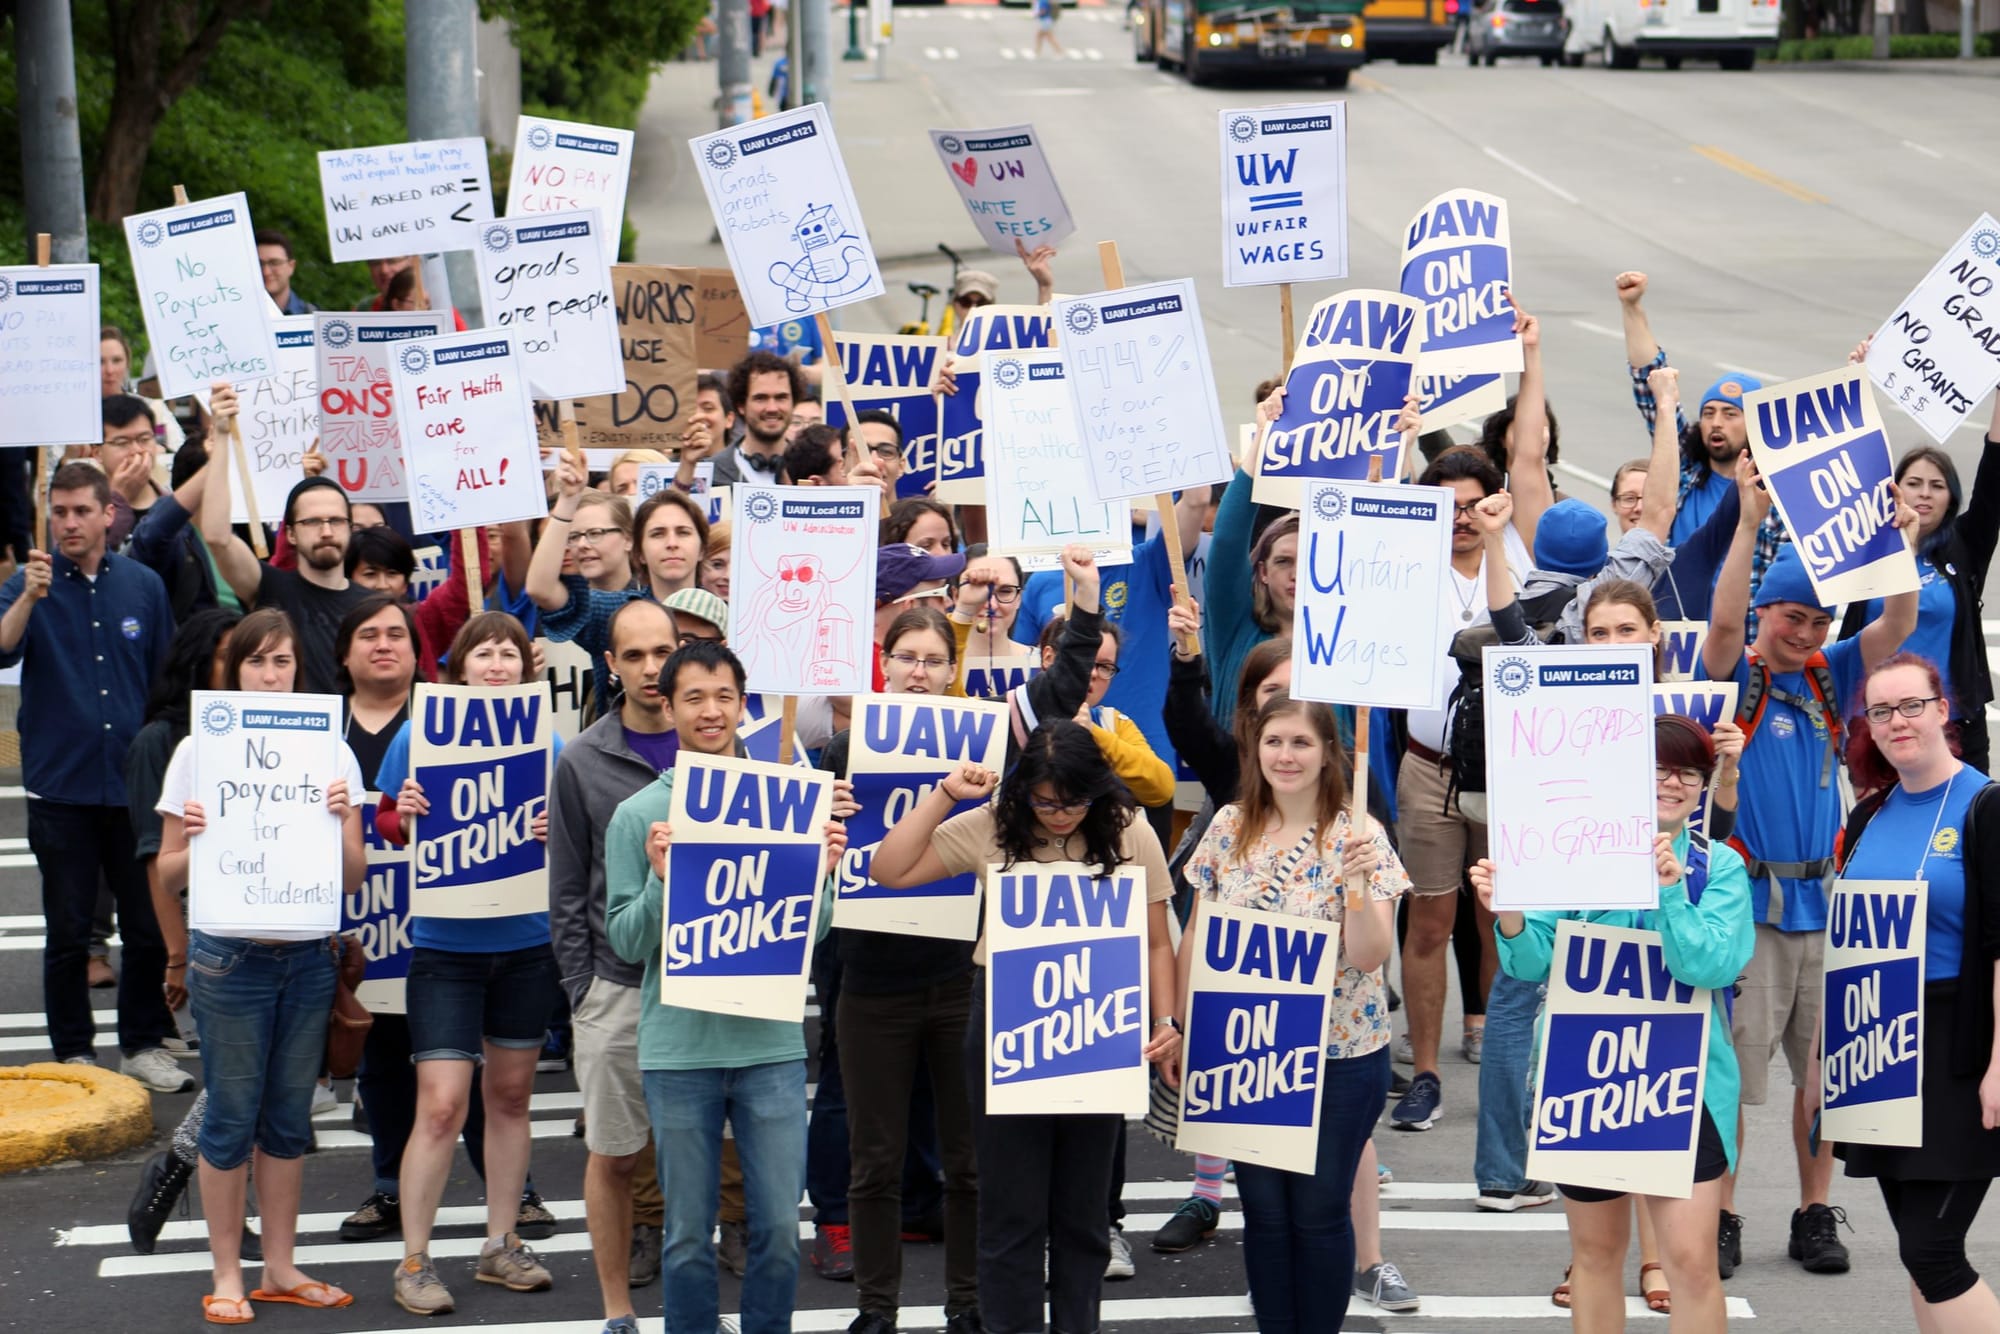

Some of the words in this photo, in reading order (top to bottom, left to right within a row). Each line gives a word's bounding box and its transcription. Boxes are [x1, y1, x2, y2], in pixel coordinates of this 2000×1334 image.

[558, 136, 577, 146] UAW
[578, 139, 598, 149] Local
[600, 142, 618, 153] 4121
[743, 139, 766, 151] UAW
[767, 132, 791, 145] Local
[792, 125, 813, 138] 4121
[1010, 137, 1030, 146] 4121
[1264, 123, 1286, 132] UAW
[1286, 120, 1309, 130] Local
[1310, 119, 1330, 129] 4121
[524, 163, 567, 187] NO
[574, 167, 612, 192] PAY
[719, 165, 778, 194] Grads
[989, 159, 1025, 182] UW
[1235, 147, 1300, 187] UW
[330, 193, 360, 213] WE
[371, 188, 423, 207] ASKED
[431, 181, 459, 197] FOR
[968, 198, 1017, 216] HATE
[170, 220, 192, 233] UAW
[191, 216, 214, 230] Local
[214, 212, 234, 225] 4121
[335, 223, 363, 244] UW
[372, 220, 409, 239] GAVE
[414, 216, 436, 232] US
[519, 230, 542, 242] UAW
[543, 227, 567, 238] Local
[568, 224, 588, 236] 4121
[727, 209, 791, 233] Robots
[995, 217, 1052, 238] FEES
[1236, 216, 1308, 238] UNFAIR
[1408, 199, 1499, 251] UAW
[175, 251, 207, 282] No
[1239, 240, 1324, 265] WAGES
[41, 283, 62, 292] Local
[63, 282, 83, 291] 4121
[494, 251, 580, 300] grads
[1424, 250, 1472, 297] ON
[1949, 259, 1994, 297] NO
[154, 277, 243, 319] Paycuts
[1104, 307, 1130, 320] UAW
[1130, 303, 1156, 317] Local
[1156, 300, 1180, 312] 4121
[277, 336, 302, 346] Local
[361, 330, 385, 340] UAW
[386, 328, 411, 339] Local
[956, 314, 1054, 358] UAW
[1305, 299, 1417, 355] UAW
[1893, 310, 1933, 345] NO
[1943, 294, 2000, 363] GRAD
[169, 335, 229, 363] Grad
[185, 353, 267, 381] Workers
[436, 350, 460, 363] UAW
[460, 346, 485, 359] Local
[486, 343, 508, 356] 4121
[836, 341, 938, 388] UAW
[1031, 366, 1058, 377] UAW
[1902, 348, 1974, 414] GRANTS
[416, 385, 452, 411] Fair
[611, 379, 679, 428] DO
[1090, 397, 1111, 418] of
[1121, 395, 1165, 413] our
[1310, 372, 1369, 415] ON
[425, 417, 466, 439] care
[1757, 378, 1866, 451] UAW
[453, 440, 479, 461] for
[1263, 408, 1403, 472] STRIKE
[1105, 448, 1134, 474] go
[1119, 450, 1215, 490] RENT
[1809, 449, 1862, 510] ON
[786, 504, 811, 515] UAW
[811, 504, 838, 515] Local
[839, 504, 861, 515] 4121
[1355, 502, 1380, 513] UAW
[1381, 504, 1409, 516] Local
[1410, 506, 1434, 517] 4121
[1801, 476, 1897, 578] STRIKE
[1309, 529, 1422, 596] Unfair
[1303, 604, 1408, 686] Wages
[1543, 670, 1573, 682] UAW
[1574, 669, 1606, 682] Local
[1608, 669, 1636, 681] 4121
[246, 715, 272, 726] UAW
[273, 715, 302, 726] Local
[303, 717, 327, 728] 4121
[424, 695, 542, 747] UAW
[864, 704, 997, 763] UAW
[1510, 706, 1567, 758] NO
[1568, 705, 1645, 757] GRADS
[245, 735, 282, 770] No
[451, 765, 504, 822] ON
[685, 767, 822, 835] UAW
[249, 811, 288, 842] for
[416, 795, 546, 884] STRIKE
[1500, 822, 1545, 867] NO
[1551, 815, 1656, 864] GRANTS
[218, 849, 266, 876] Grad
[706, 849, 771, 907] ON
[1001, 874, 1134, 929] UAW
[1831, 891, 1917, 950] UAW
[667, 894, 813, 972] STRIKE
[1205, 915, 1328, 987] UAW
[1033, 946, 1091, 1009] ON
[1564, 934, 1697, 1005] UAW
[1843, 969, 1881, 1033] ON
[992, 985, 1142, 1079] STRIKE
[1225, 999, 1280, 1055] ON
[1587, 1020, 1652, 1080] ON
[1824, 1011, 1919, 1104] STRIKE
[1186, 1046, 1320, 1117] STRIKE
[1538, 1065, 1699, 1145] STRIKE
